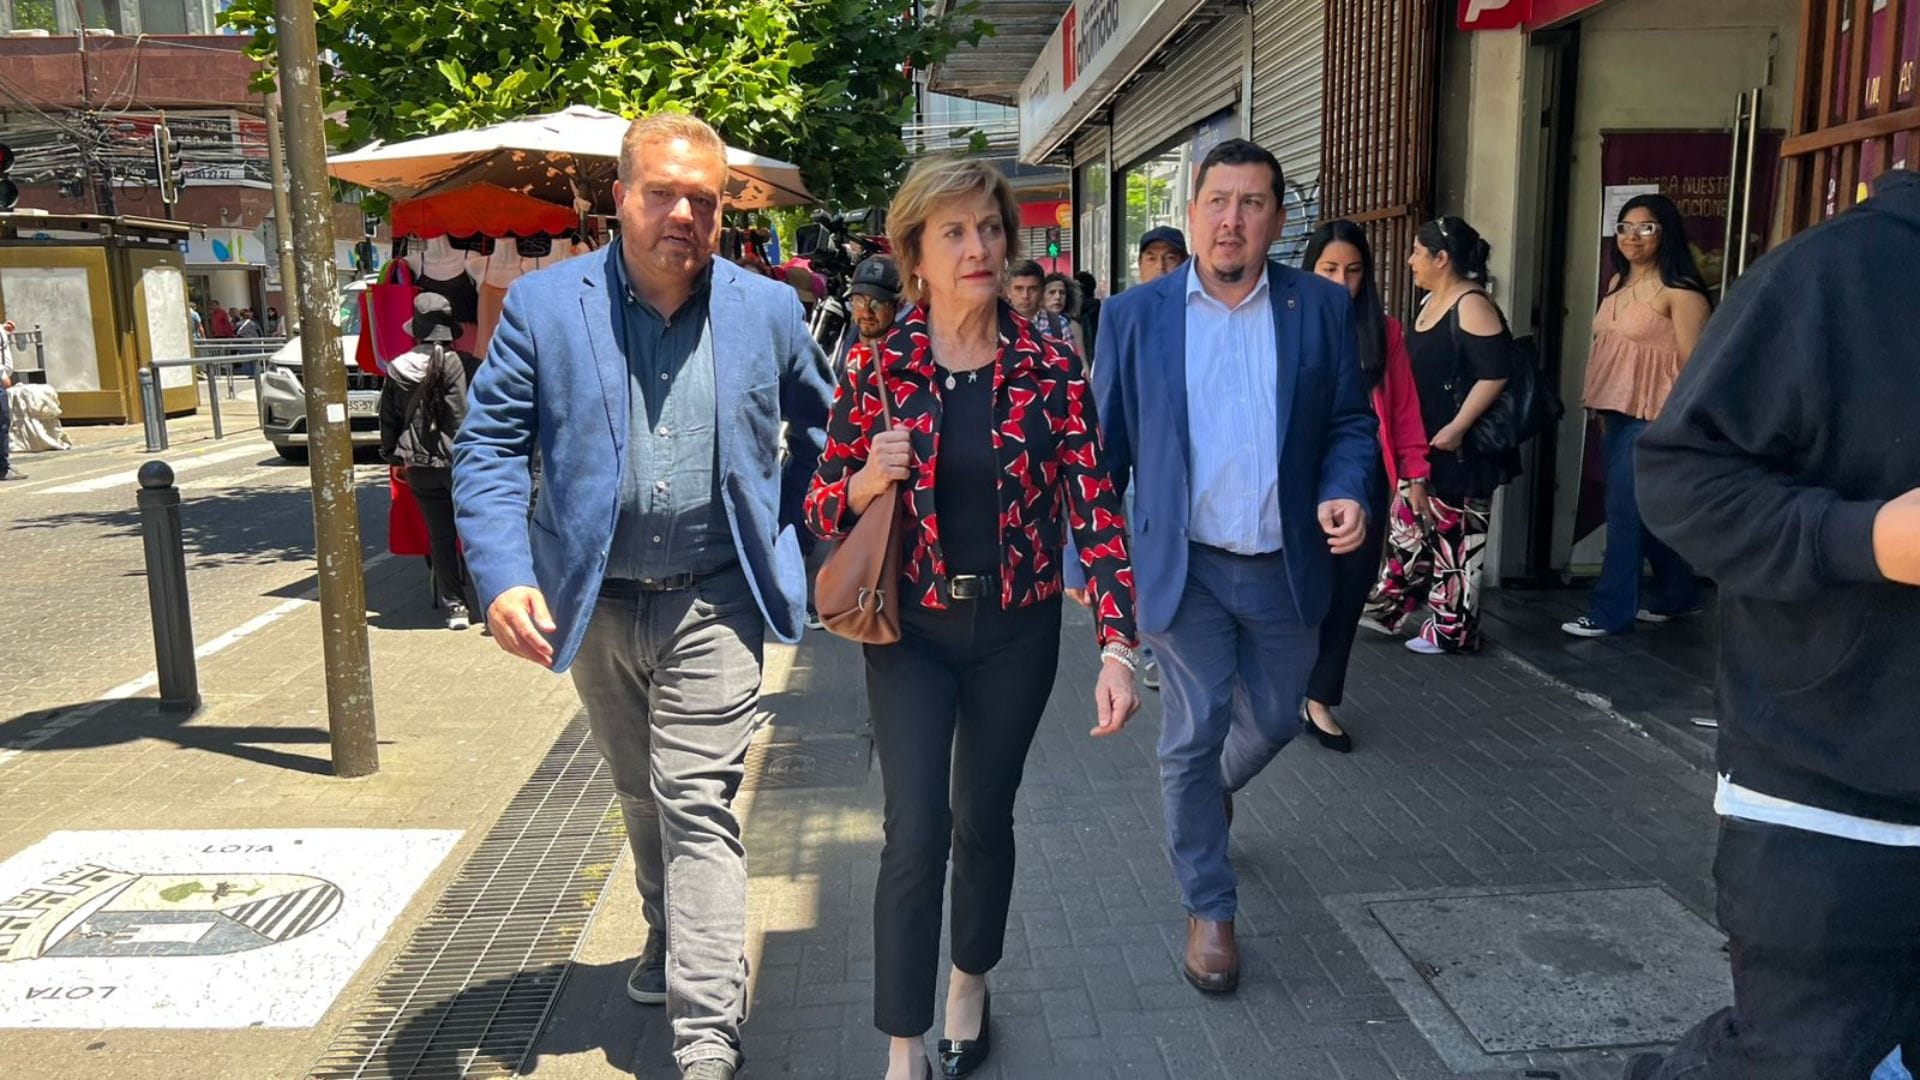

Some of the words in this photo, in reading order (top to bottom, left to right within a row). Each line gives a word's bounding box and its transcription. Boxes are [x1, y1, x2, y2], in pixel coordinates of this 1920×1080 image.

[1682, 177, 1732, 194] NUESTR
[202, 844, 274, 853] LOTA
[25, 986, 118, 999] LOTA
